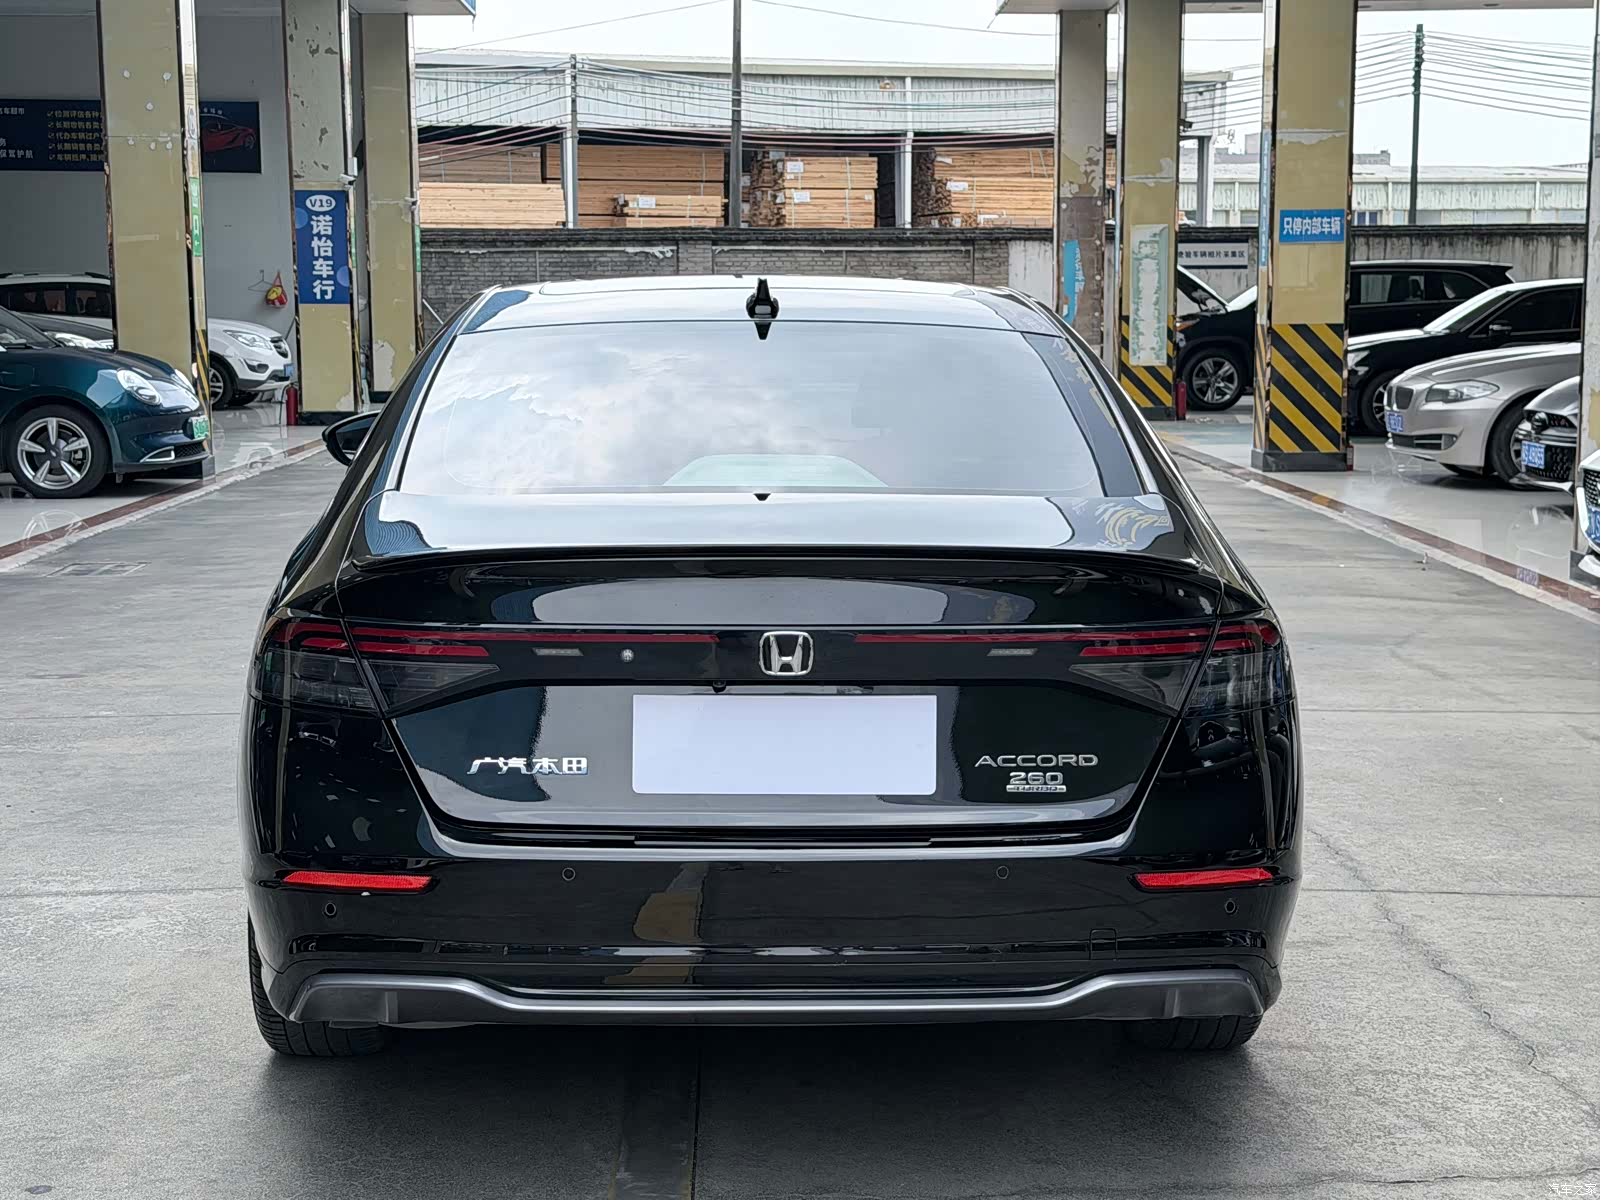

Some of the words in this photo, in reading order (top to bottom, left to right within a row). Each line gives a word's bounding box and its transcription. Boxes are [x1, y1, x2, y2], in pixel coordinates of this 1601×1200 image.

[309, 198, 333, 209] V19
[1283, 216, 1341, 235] 只停内部车辆
[310, 214, 335, 300] 诺怡车行
[466, 756, 588, 775] 广汽本田
[974, 754, 1099, 768] ACCORD
[1009, 771, 1064, 785] 260
